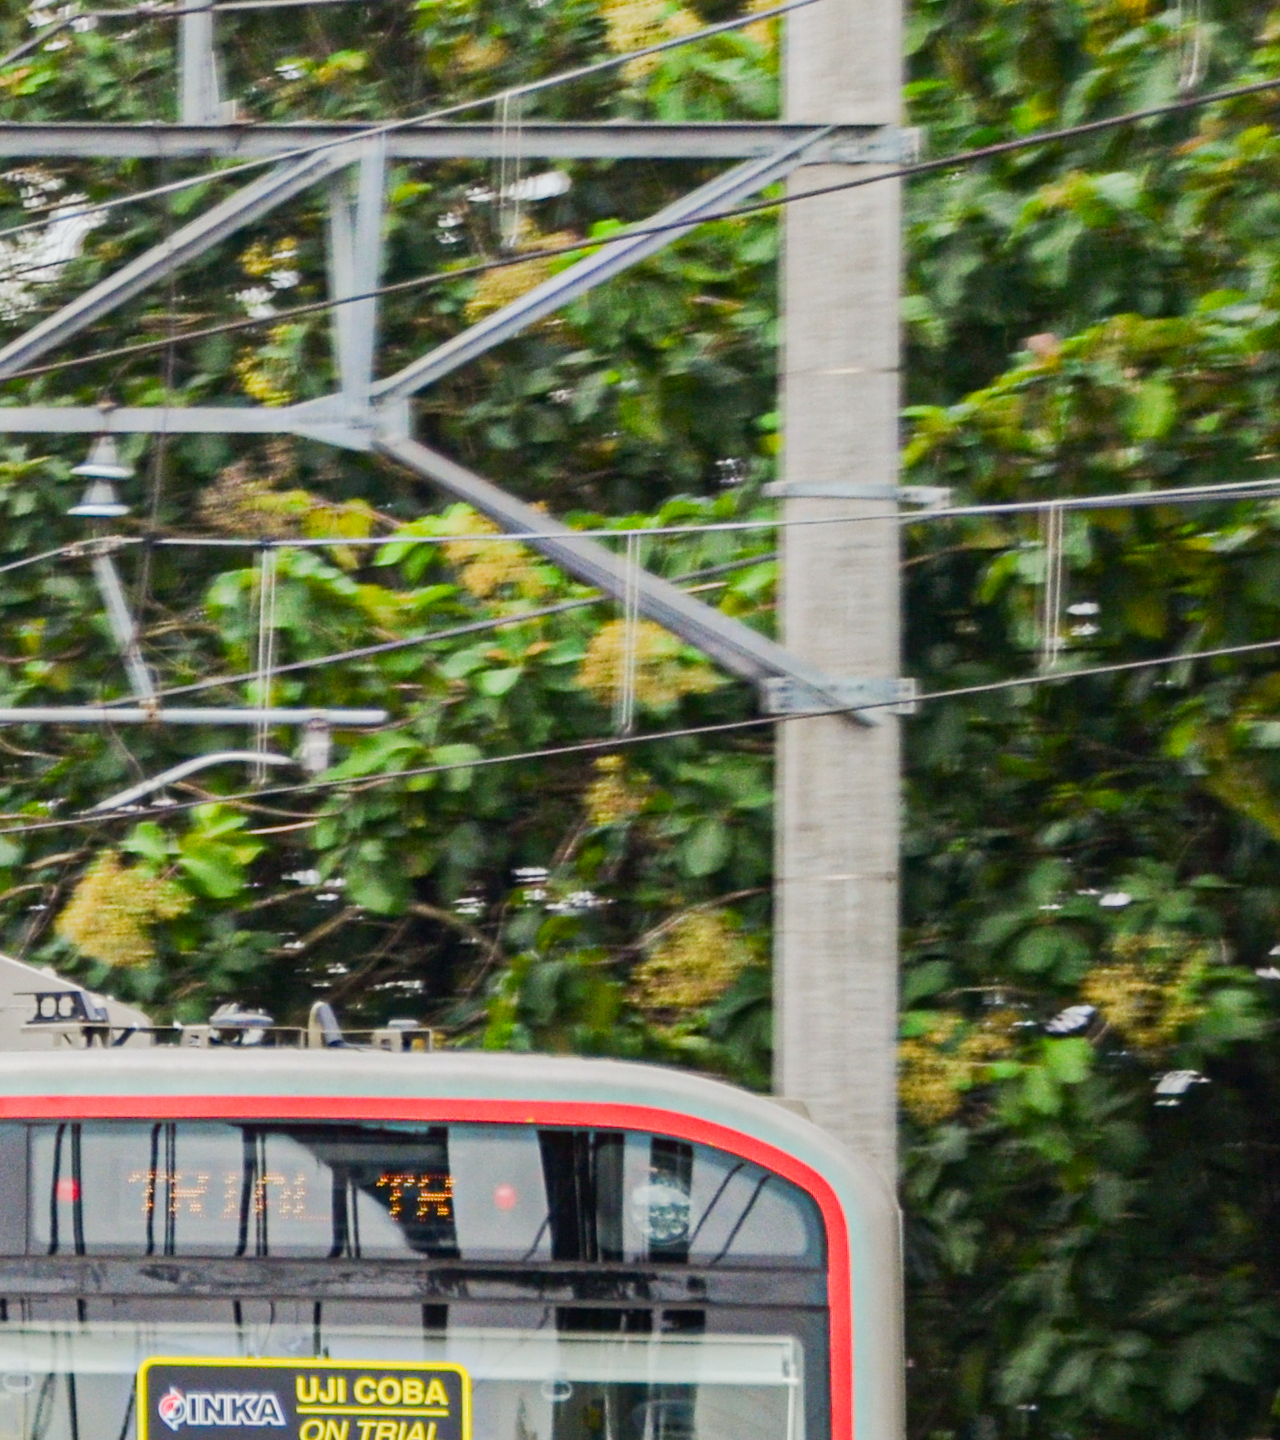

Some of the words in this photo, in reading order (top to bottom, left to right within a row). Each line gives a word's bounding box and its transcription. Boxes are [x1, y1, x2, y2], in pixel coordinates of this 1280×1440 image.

[296, 1376, 347, 1404] UJI
[354, 1377, 449, 1406] COBA
[187, 1393, 287, 1426] INKA
